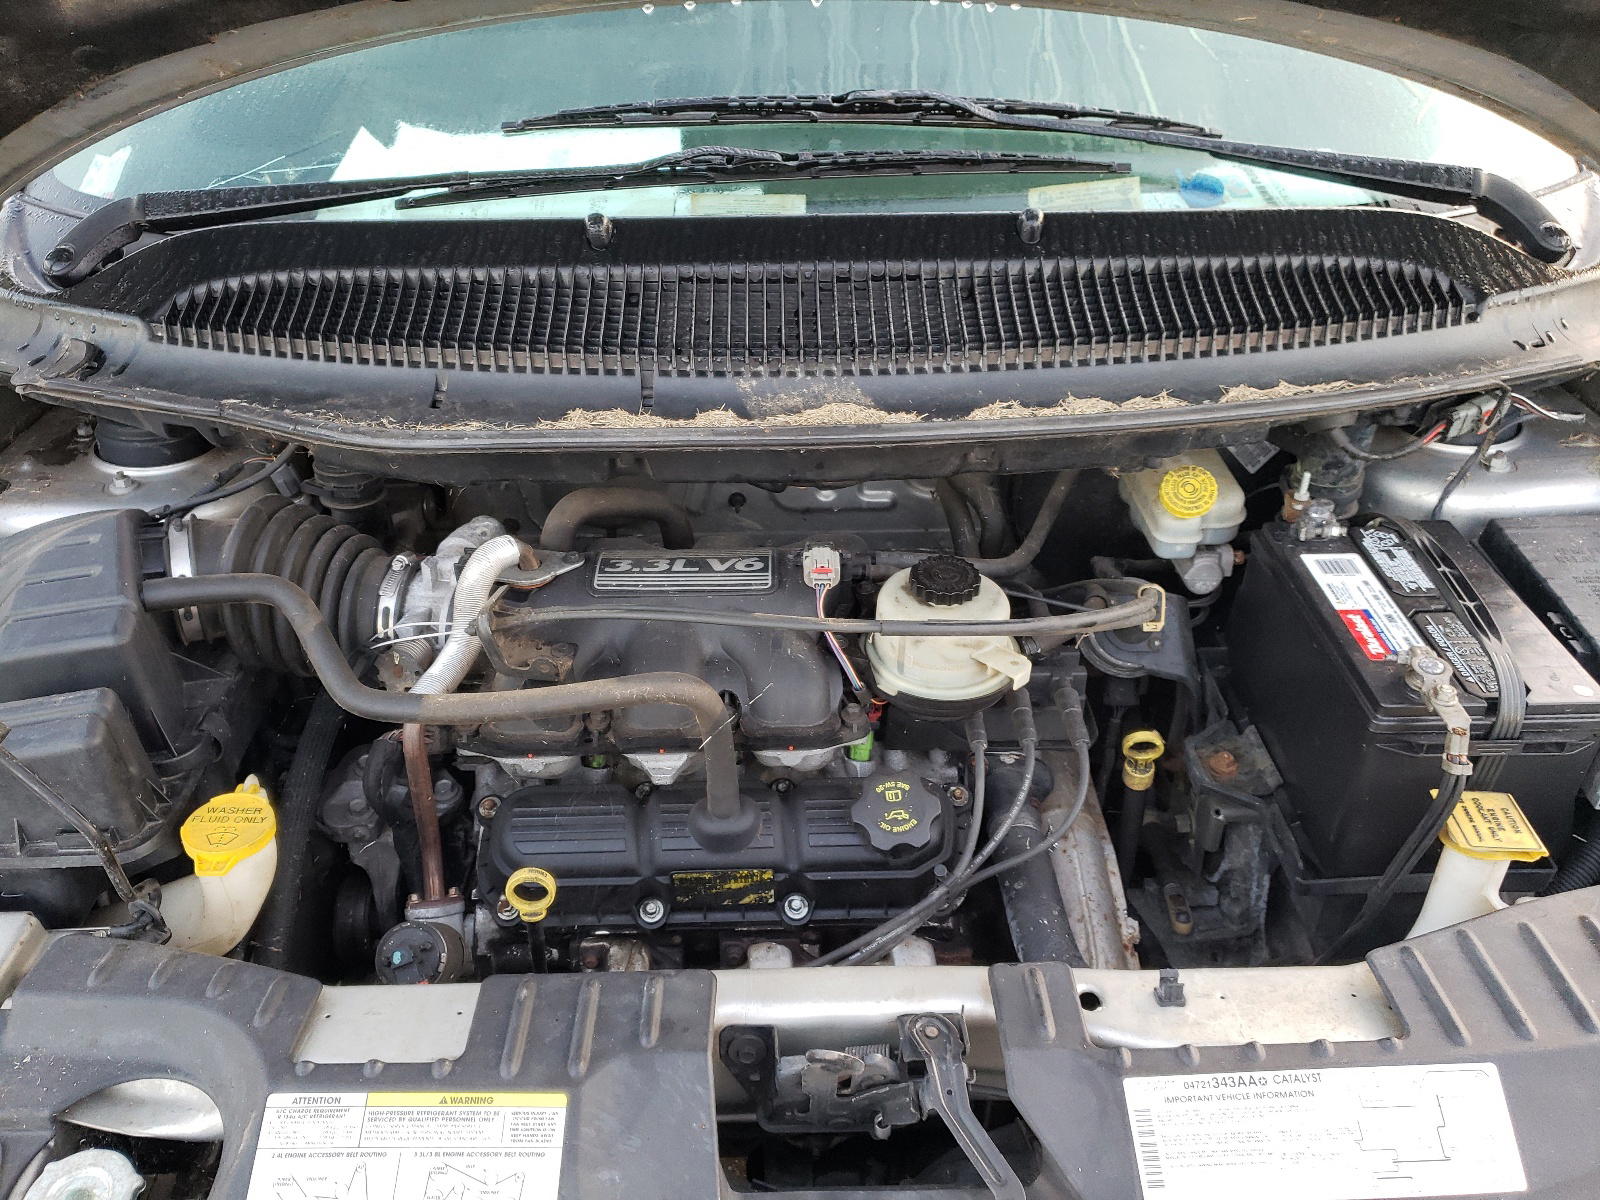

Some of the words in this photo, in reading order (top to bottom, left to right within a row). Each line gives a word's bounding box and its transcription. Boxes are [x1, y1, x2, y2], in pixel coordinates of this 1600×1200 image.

[604, 559, 699, 572] 3.3L
[706, 557, 765, 572] V6
[875, 781, 896, 793] 5W-20
[896, 781, 911, 791] SAE
[207, 806, 263, 815] WASHER
[1472, 797, 1492, 825] COOLANT
[191, 815, 230, 823] FLUID
[233, 816, 267, 824] ONLY
[892, 818, 918, 832] ENGINE
[1486, 808, 1506, 831] ENGINE
[1500, 807, 1522, 834] CAUTION
[1272, 1072, 1322, 1085] CATALYST
[291, 1096, 342, 1105] ATTENTION
[449, 1096, 494, 1105] WARNING
[1164, 1093, 1215, 1104] IMPORTANT
[1215, 1092, 1250, 1102] VEHICLE
[1253, 1089, 1315, 1100] INFORMATION
